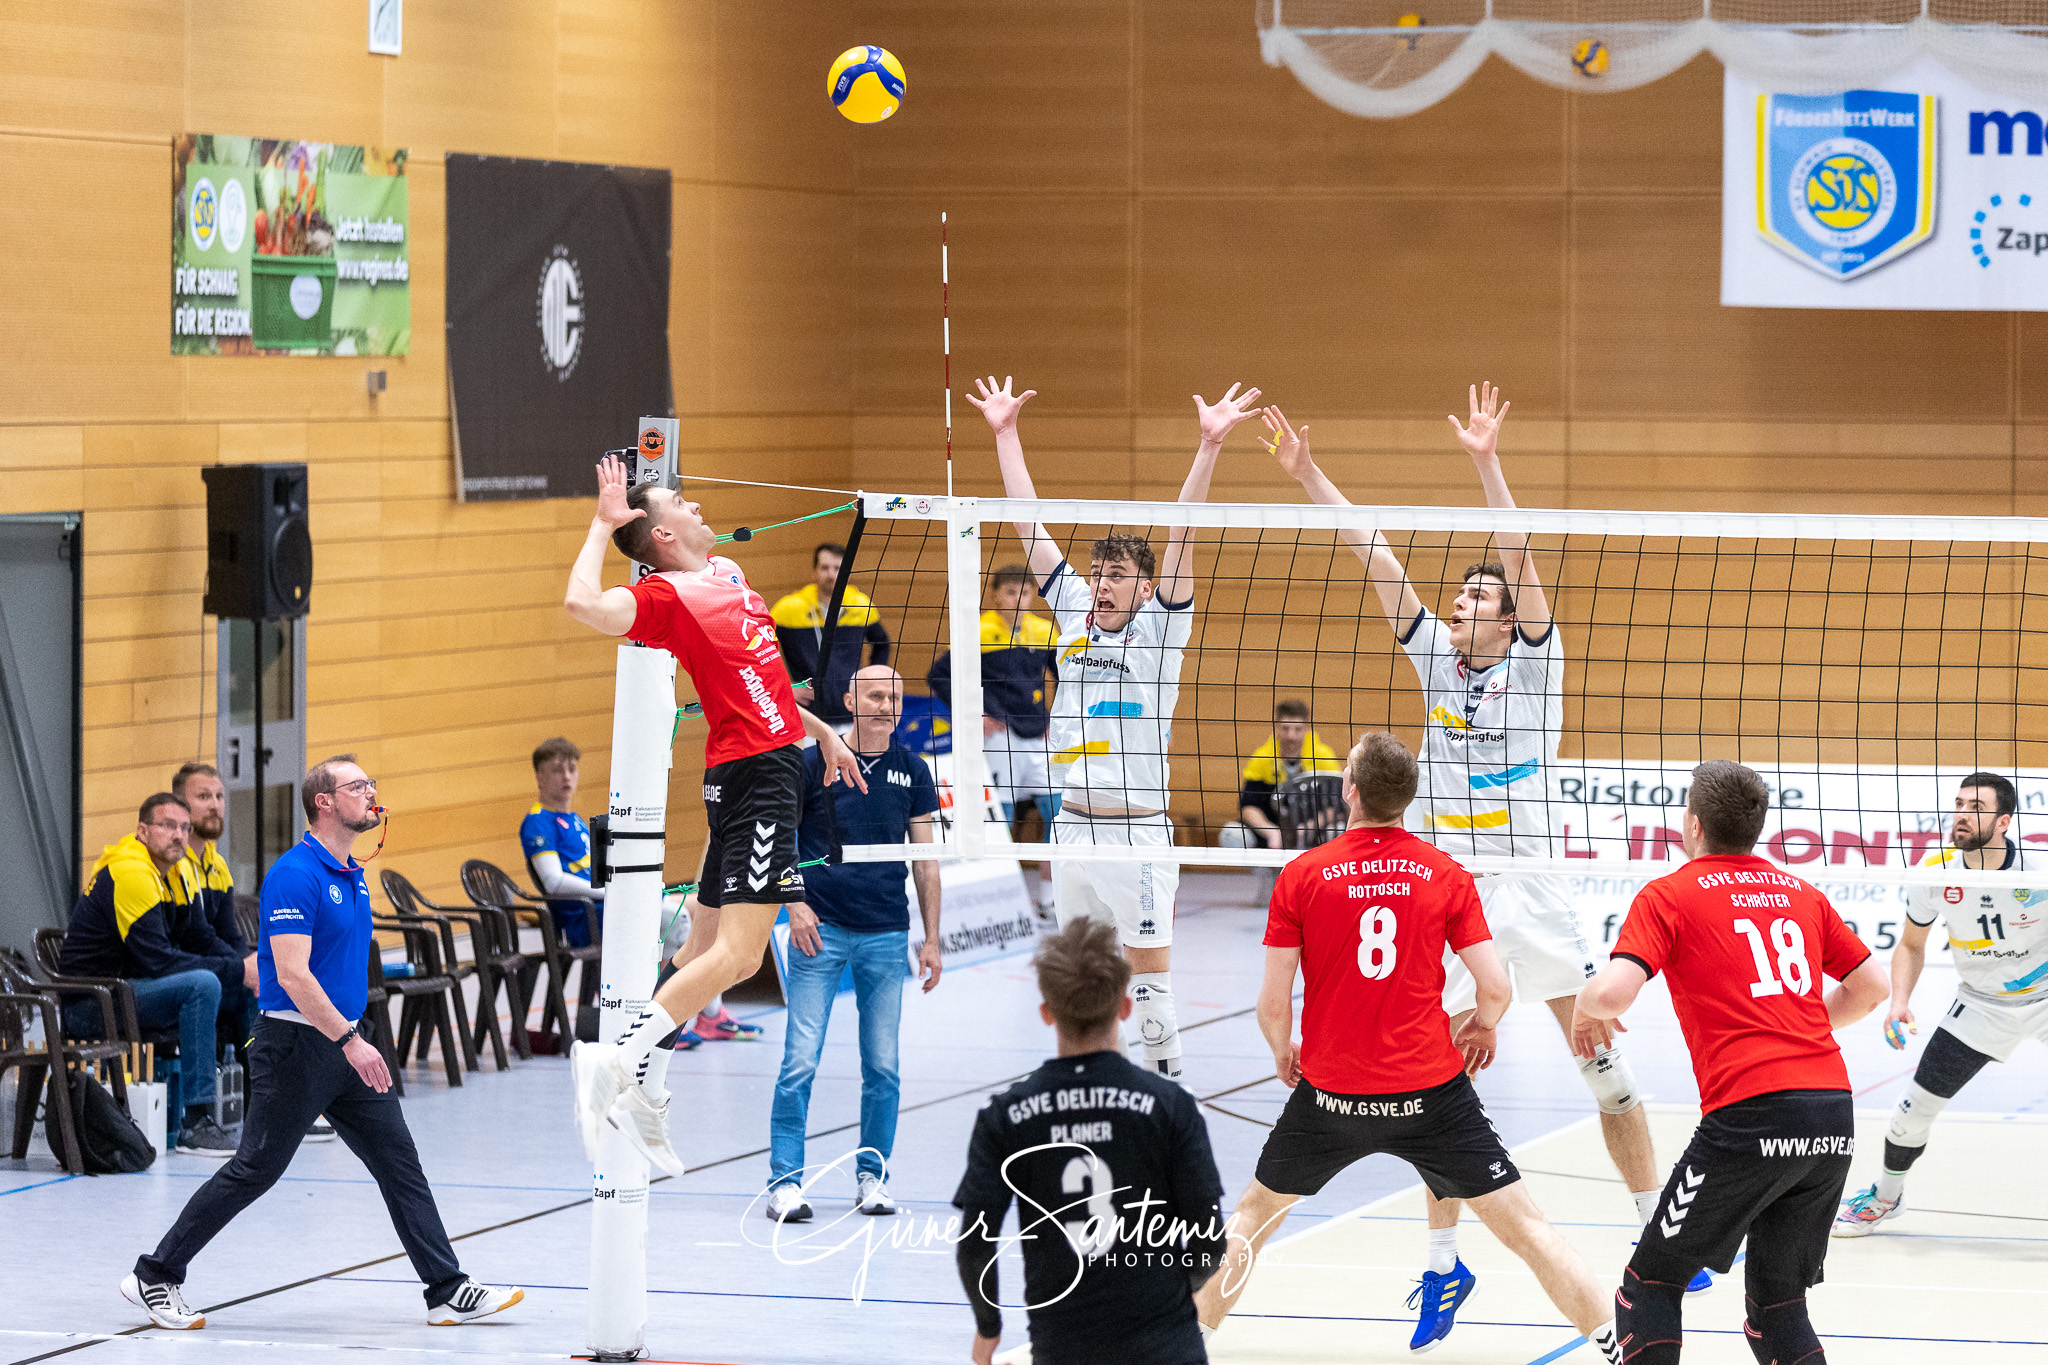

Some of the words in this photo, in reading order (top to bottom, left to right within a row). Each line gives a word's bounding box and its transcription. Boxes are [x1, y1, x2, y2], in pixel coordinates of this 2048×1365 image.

[1969, 110, 2048, 156] m
[335, 216, 364, 242] Jetzt
[175, 262, 197, 295] FÜR
[175, 302, 197, 336] FÜR
[197, 307, 214, 335] DIE
[887, 769, 912, 788] MM
[611, 805, 632, 817] Zapf
[1322, 861, 1358, 881] GSVE
[1361, 859, 1433, 882] DELITZSCH
[1697, 871, 1735, 890] GSVE
[1734, 871, 1803, 892] DELITZSCH
[1348, 882, 1411, 899] ROTTOSCH
[1730, 891, 1791, 908] SCHRÖTER
[1976, 913, 2006, 940] 11
[1357, 905, 1397, 980] 8
[1733, 918, 1813, 998] 18
[601, 997, 622, 1010] Zapf
[1008, 1091, 1054, 1125] GSVE
[1055, 1086, 1156, 1116] DELITZSCH
[1316, 1089, 1424, 1117] WWW.GSVE.DE
[1050, 1121, 1113, 1144] PLANER
[594, 1187, 616, 1200] Zapf
[1061, 1154, 1118, 1257] 3
